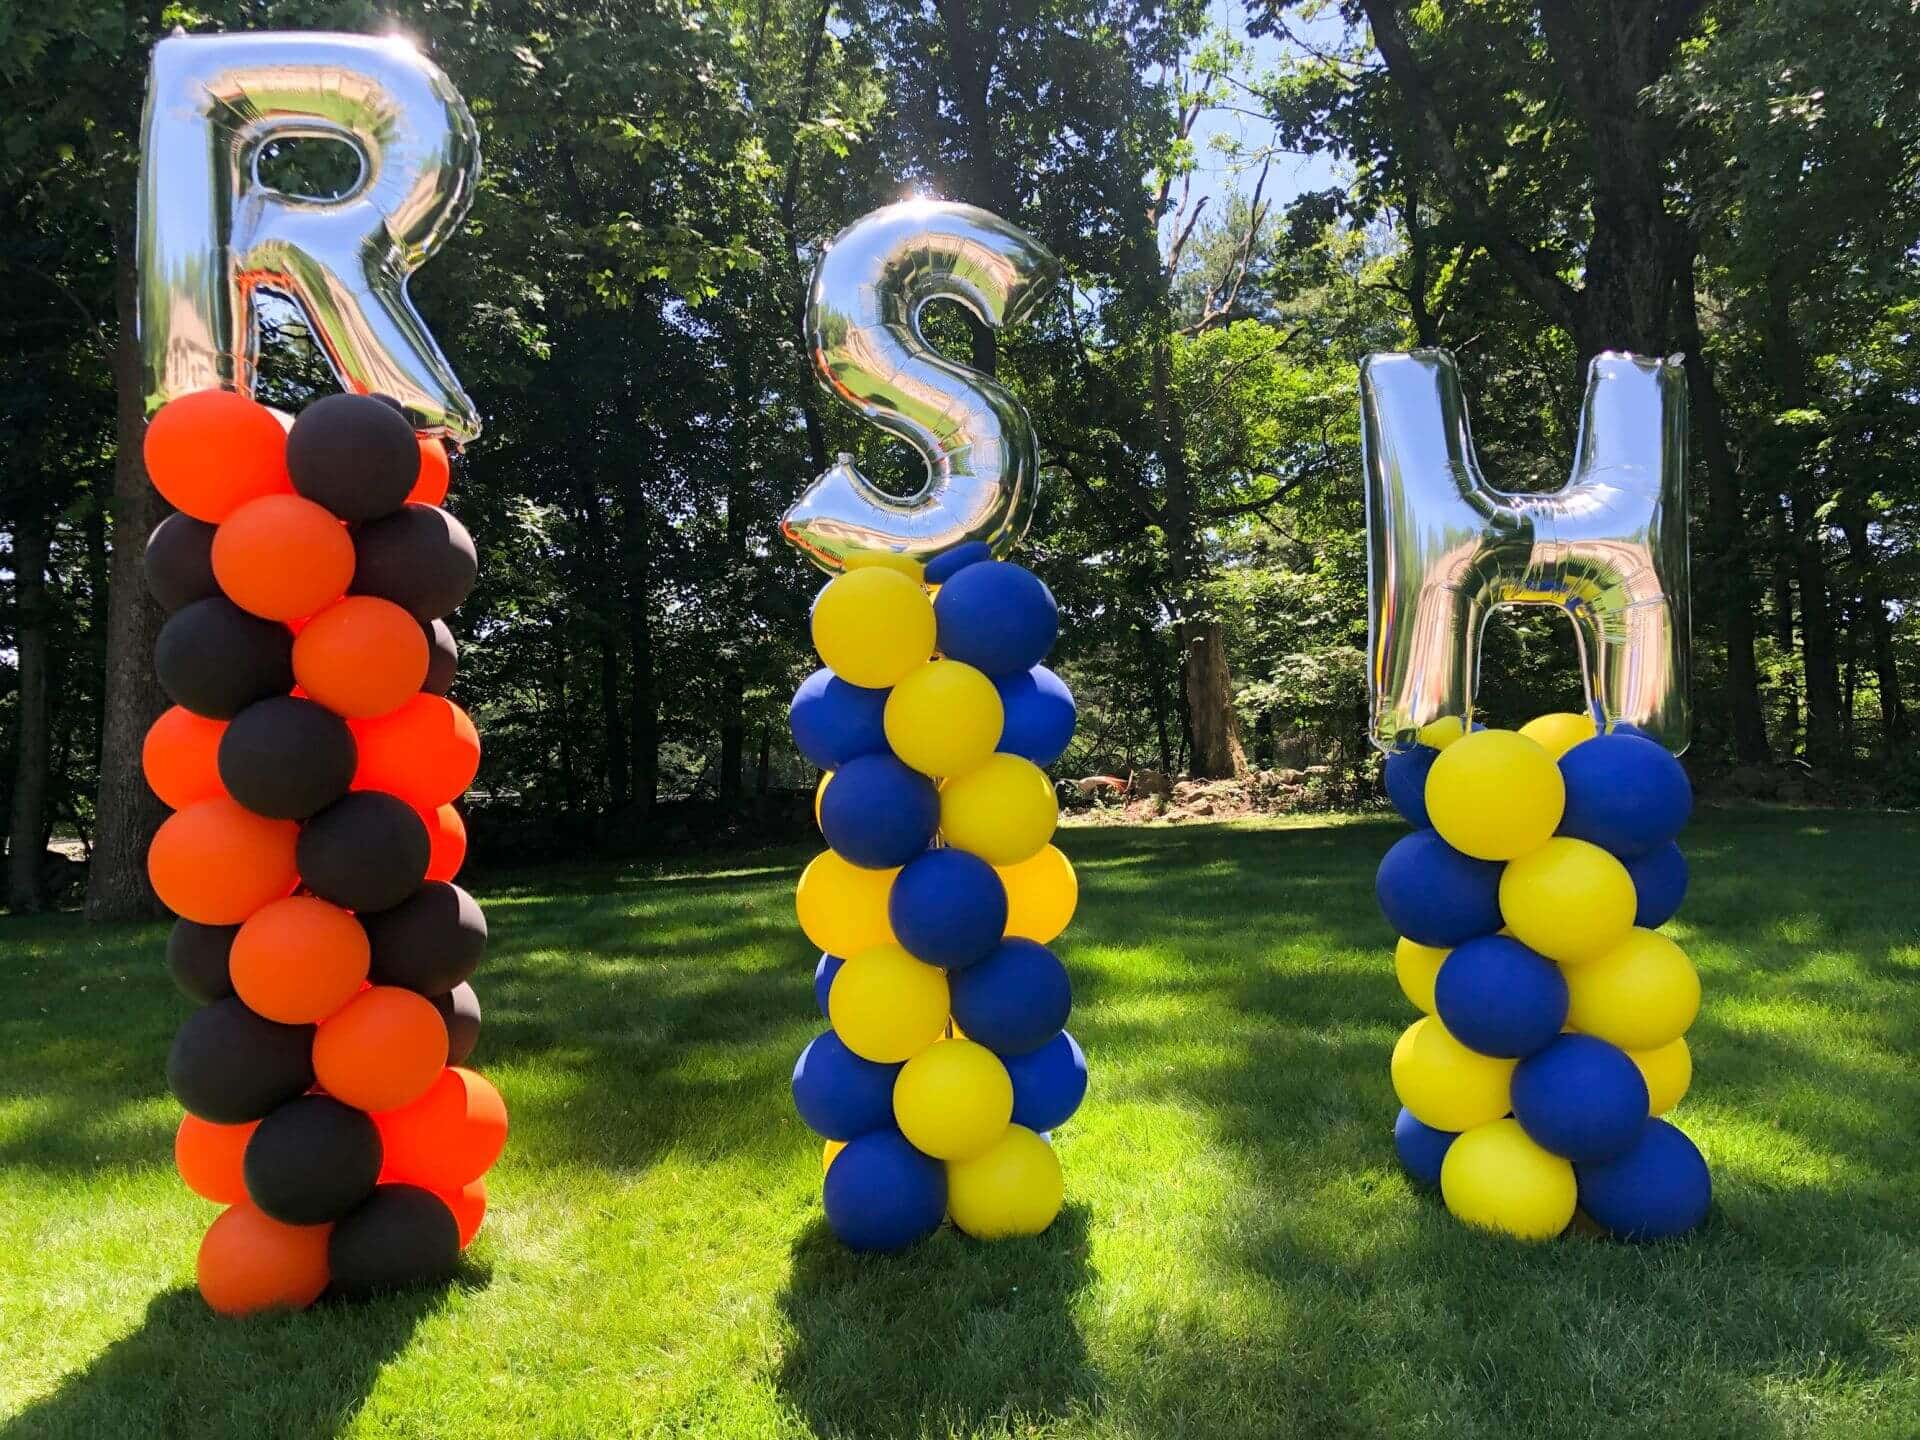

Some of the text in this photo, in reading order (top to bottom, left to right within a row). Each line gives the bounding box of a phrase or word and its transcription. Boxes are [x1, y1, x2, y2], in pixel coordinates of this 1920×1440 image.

[137, 30, 482, 443] R
[781, 198, 1060, 577] S
[1361, 347, 1692, 757] H
